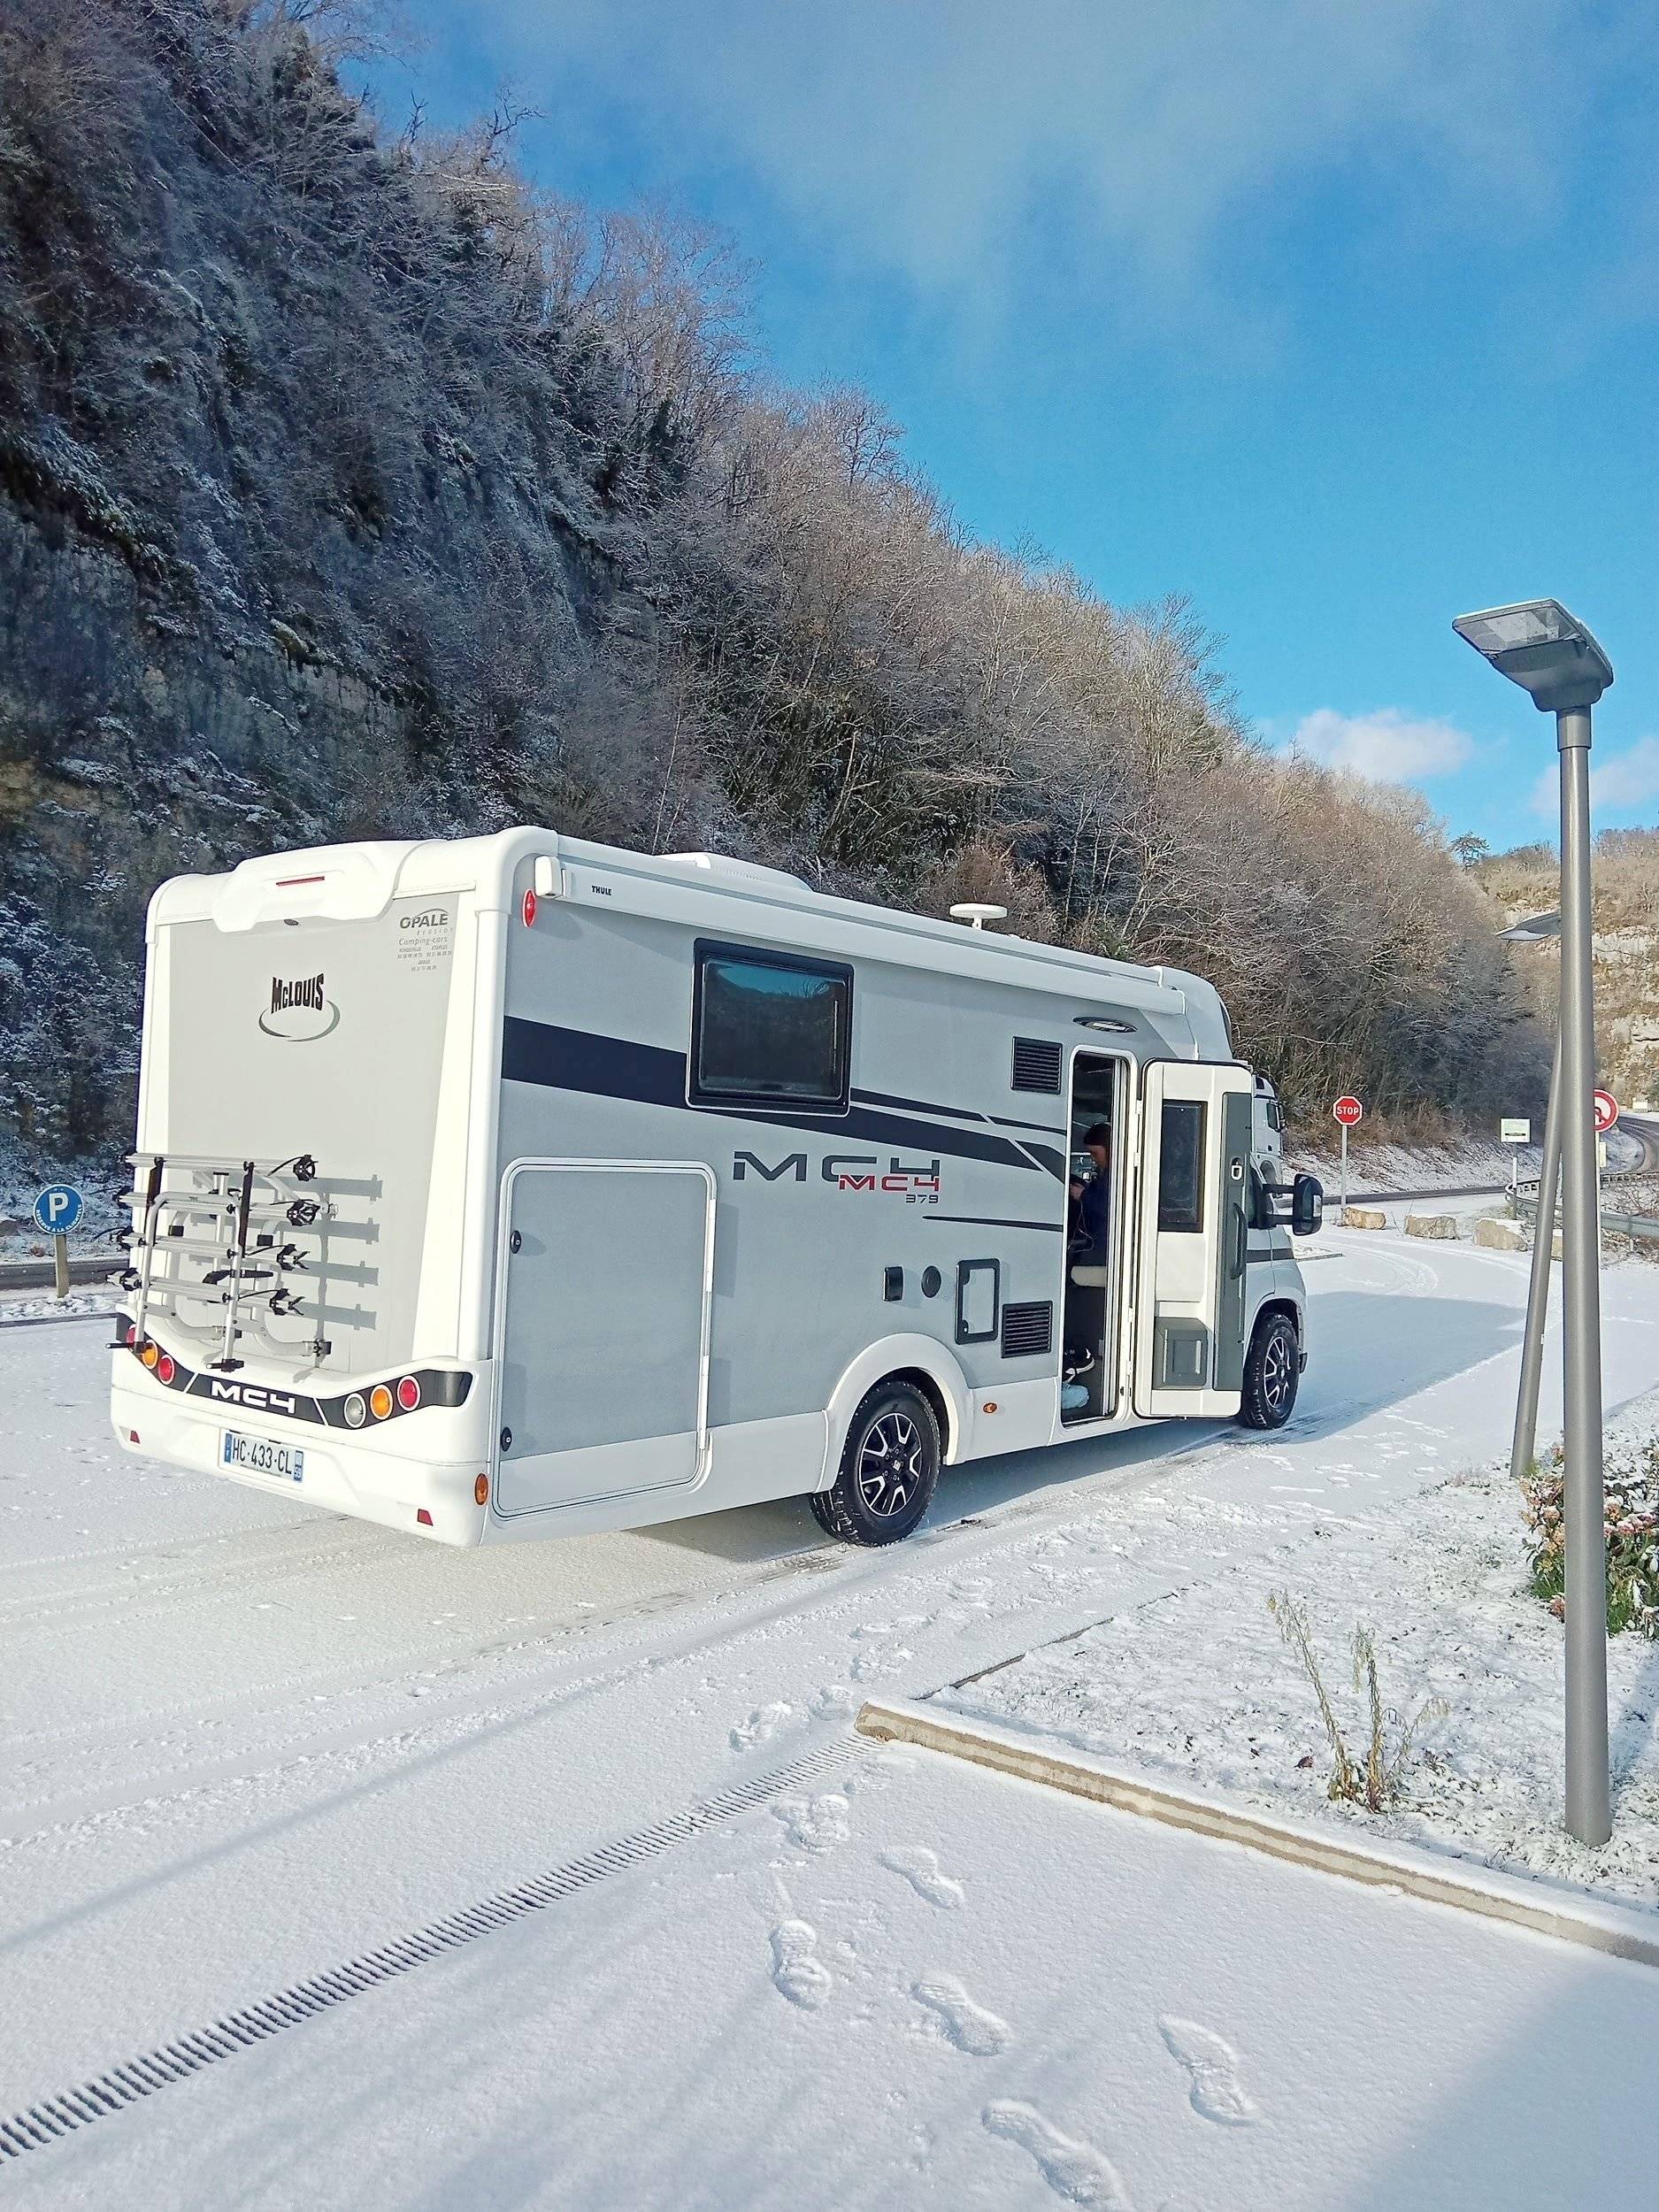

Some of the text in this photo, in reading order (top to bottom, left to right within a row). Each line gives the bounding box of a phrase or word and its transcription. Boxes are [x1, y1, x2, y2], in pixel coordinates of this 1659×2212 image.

[591, 885, 611, 895] THULE
[400, 914, 449, 928] OPALE
[1336, 1106, 1359, 1116] STOP
[839, 1174, 940, 1192] MC4
[49, 1193, 68, 1221] P
[905, 1194, 939, 1204] 379
[211, 1380, 296, 1414] MC4
[233, 1438, 292, 1474] HC-433-CL
